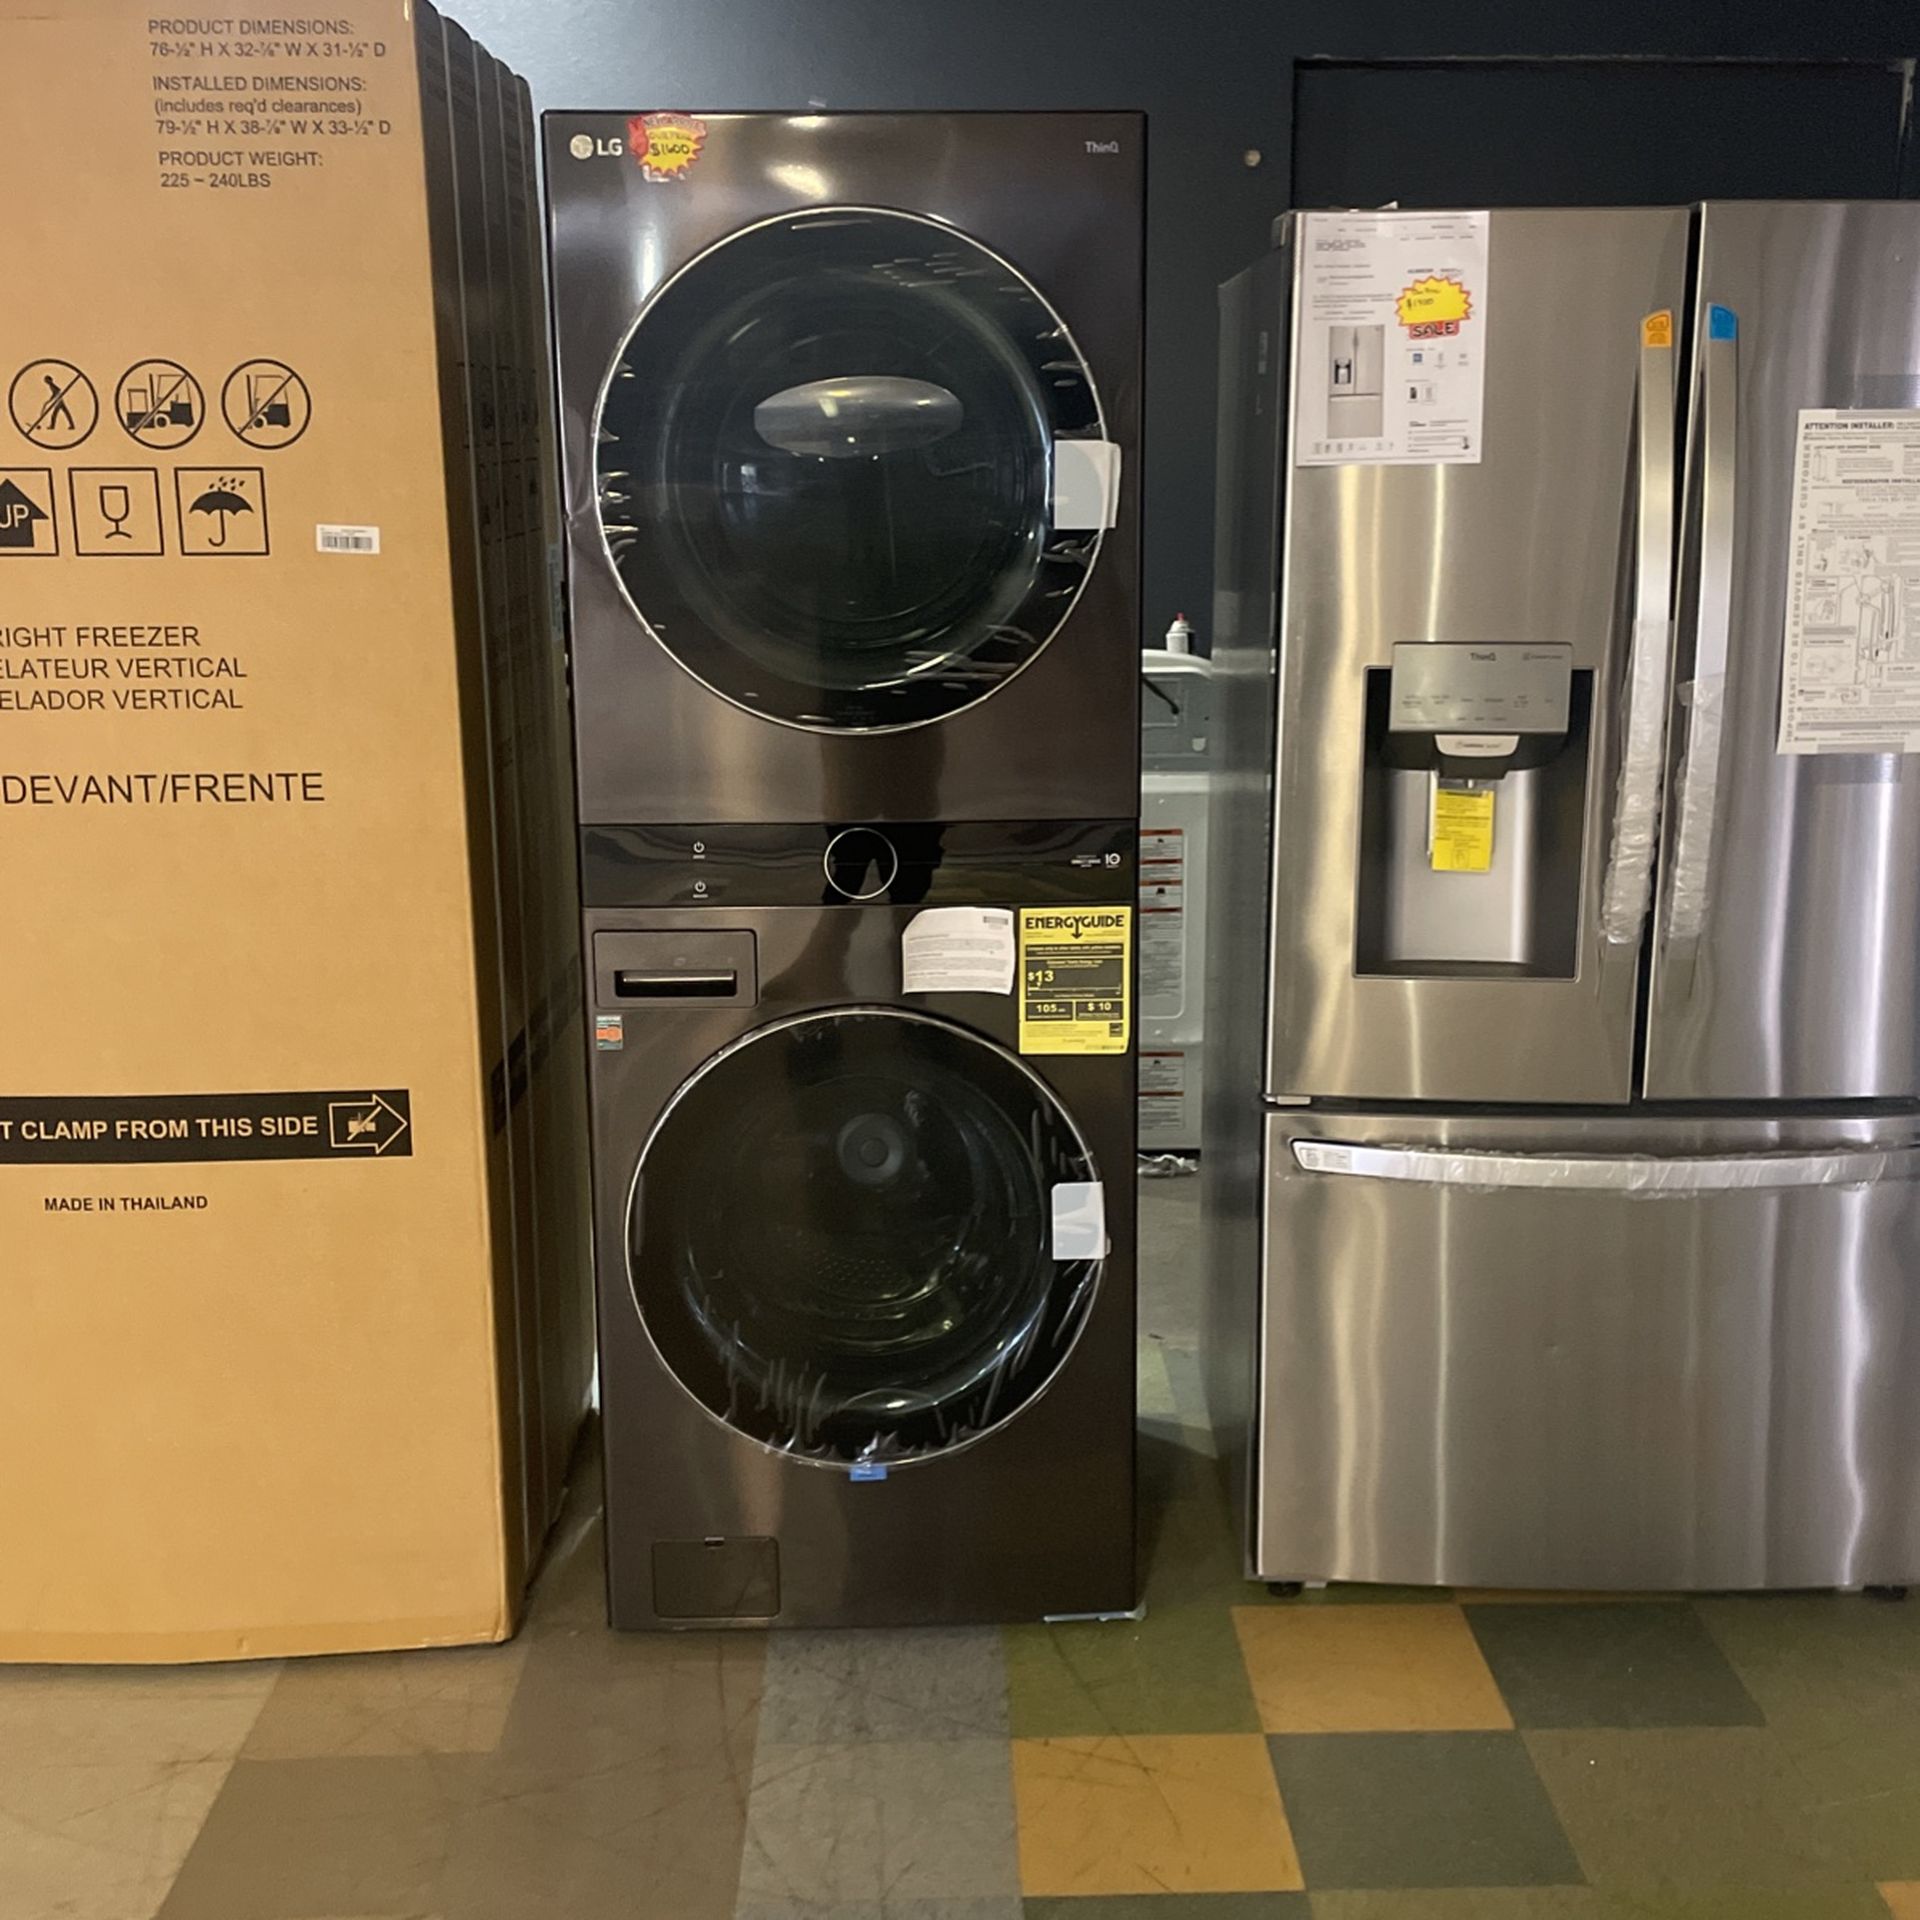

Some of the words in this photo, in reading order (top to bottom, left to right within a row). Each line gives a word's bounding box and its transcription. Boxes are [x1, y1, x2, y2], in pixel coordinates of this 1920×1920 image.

[148, 20, 233, 34] PRODUCT
[239, 20, 354, 34] DIMENSIONS:
[200, 43, 213, 57] H
[218, 43, 230, 57] X
[285, 43, 302, 56] W
[306, 43, 319, 56] X
[374, 43, 386, 56] D
[152, 76, 248, 91] INSTALLED
[252, 76, 367, 91] DIMENSIONS:
[154, 99, 225, 116] (includes
[229, 99, 267, 115] req'd
[272, 98, 362, 115] clearances)
[207, 120, 219, 135] H
[224, 120, 236, 135] X
[291, 120, 308, 134] W
[312, 120, 325, 134] X
[379, 120, 392, 134] D
[597, 138, 623, 156] LG
[1084, 140, 1120, 153] ThinQ
[158, 151, 244, 166] PRODUCT
[248, 151, 323, 166] WEIGHT:
[160, 173, 190, 188] 225
[209, 173, 271, 188] 240LBS
[1412, 322, 1455, 338] SALE
[1804, 422, 1849, 431] ATTENTION
[0, 626, 67, 648] IGHT
[75, 626, 201, 648] FREEZER
[116, 657, 248, 678] VERTICAL
[112, 689, 244, 710] VERTICAL
[1, 772, 325, 804] DEVANT/FRENTE
[1025, 914, 1125, 936] ENERGYGUIDE
[1027, 970, 1054, 983] $13
[1036, 1004, 1057, 1013] 105
[20, 1119, 109, 1140] CLAMP
[115, 1118, 190, 1140] FROM
[195, 1116, 253, 1138] THIS
[260, 1115, 319, 1136] SIDE
[44, 1197, 94, 1212] MADE
[98, 1197, 116, 1211] IN
[119, 1195, 208, 1210] THAILAND
